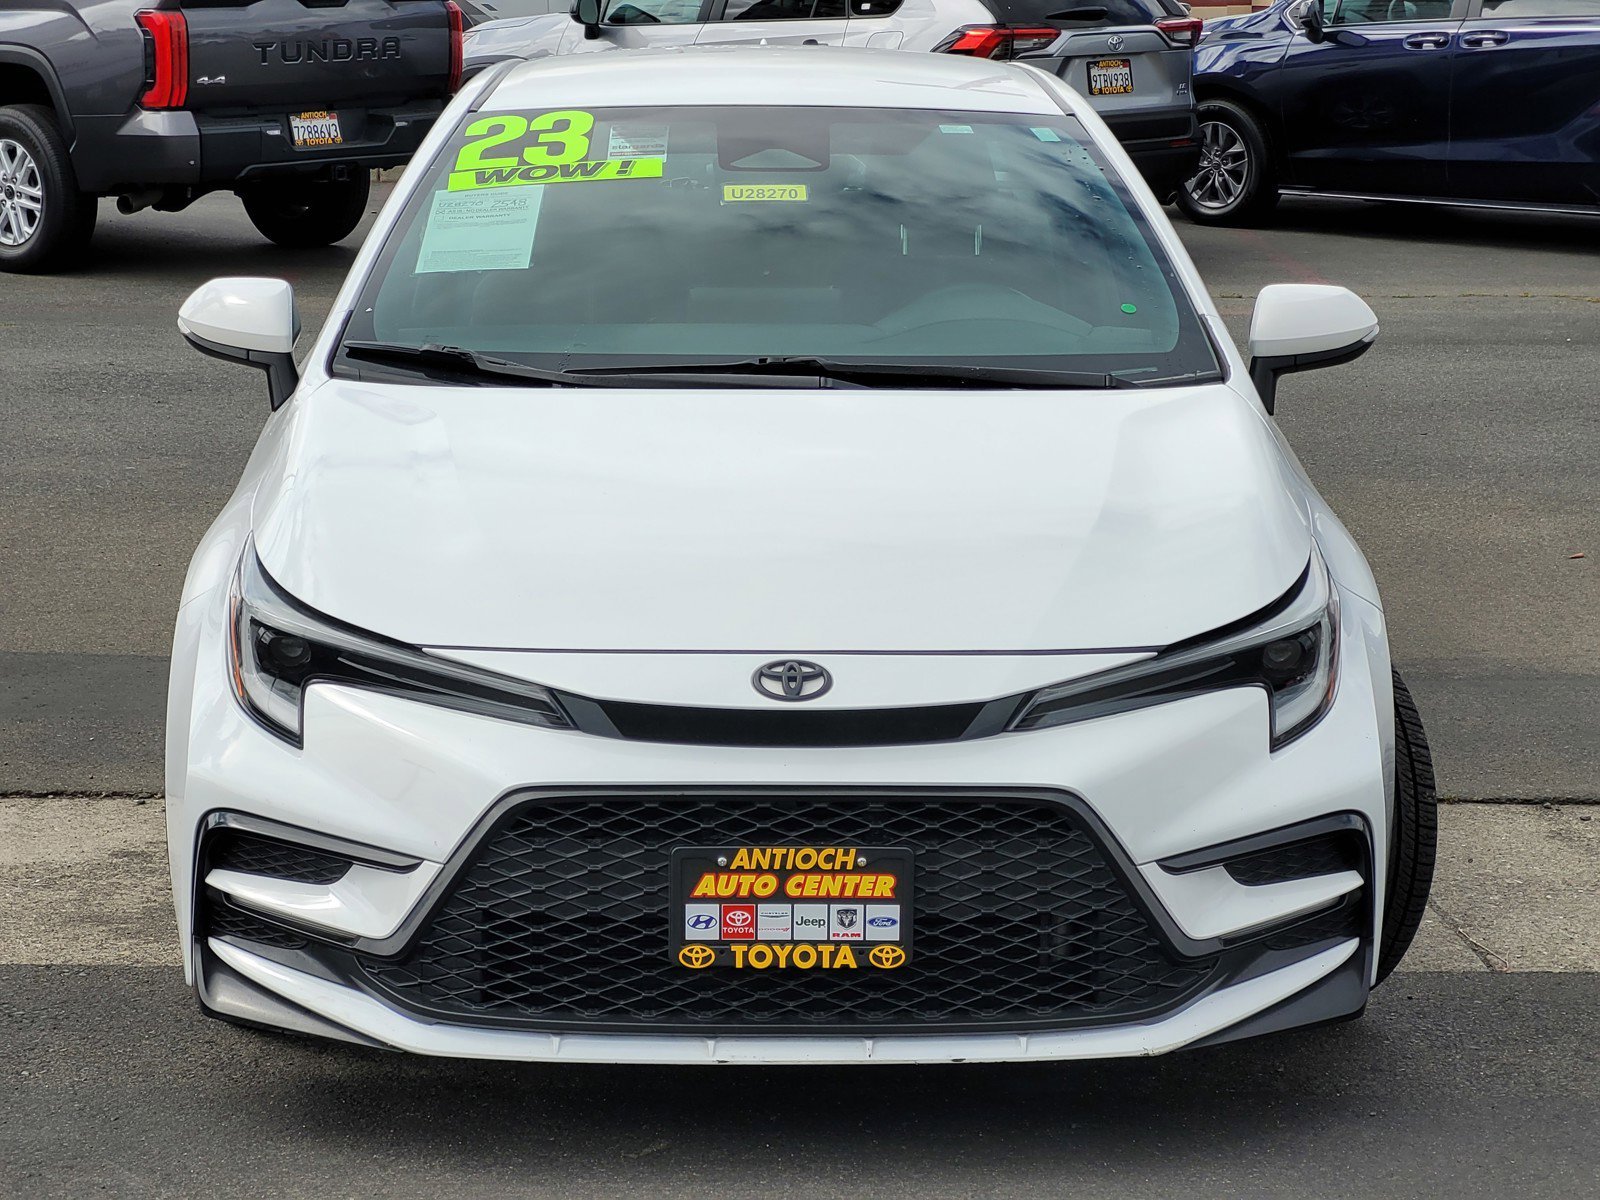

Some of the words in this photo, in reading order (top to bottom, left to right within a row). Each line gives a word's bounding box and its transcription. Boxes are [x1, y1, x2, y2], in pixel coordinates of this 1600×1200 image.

[252, 37, 401, 65] TUNDRA
[1099, 60, 1121, 68] ANTIOCH
[1092, 72, 1130, 88] 9TBV938
[1102, 86, 1125, 94] TOYOTA
[301, 111, 327, 119] ANTIOCH
[293, 123, 339, 140] 72886V3
[306, 137, 333, 146] TOYOTA
[455, 110, 595, 171] 23
[731, 188, 799, 199] U28270
[730, 847, 857, 870] ANTIOCH
[690, 873, 779, 898] AUTO
[784, 873, 897, 898] CENTER
[795, 916, 826, 928] Jeep
[873, 918, 893, 927] Ford
[730, 944, 857, 970] TOYOTA
